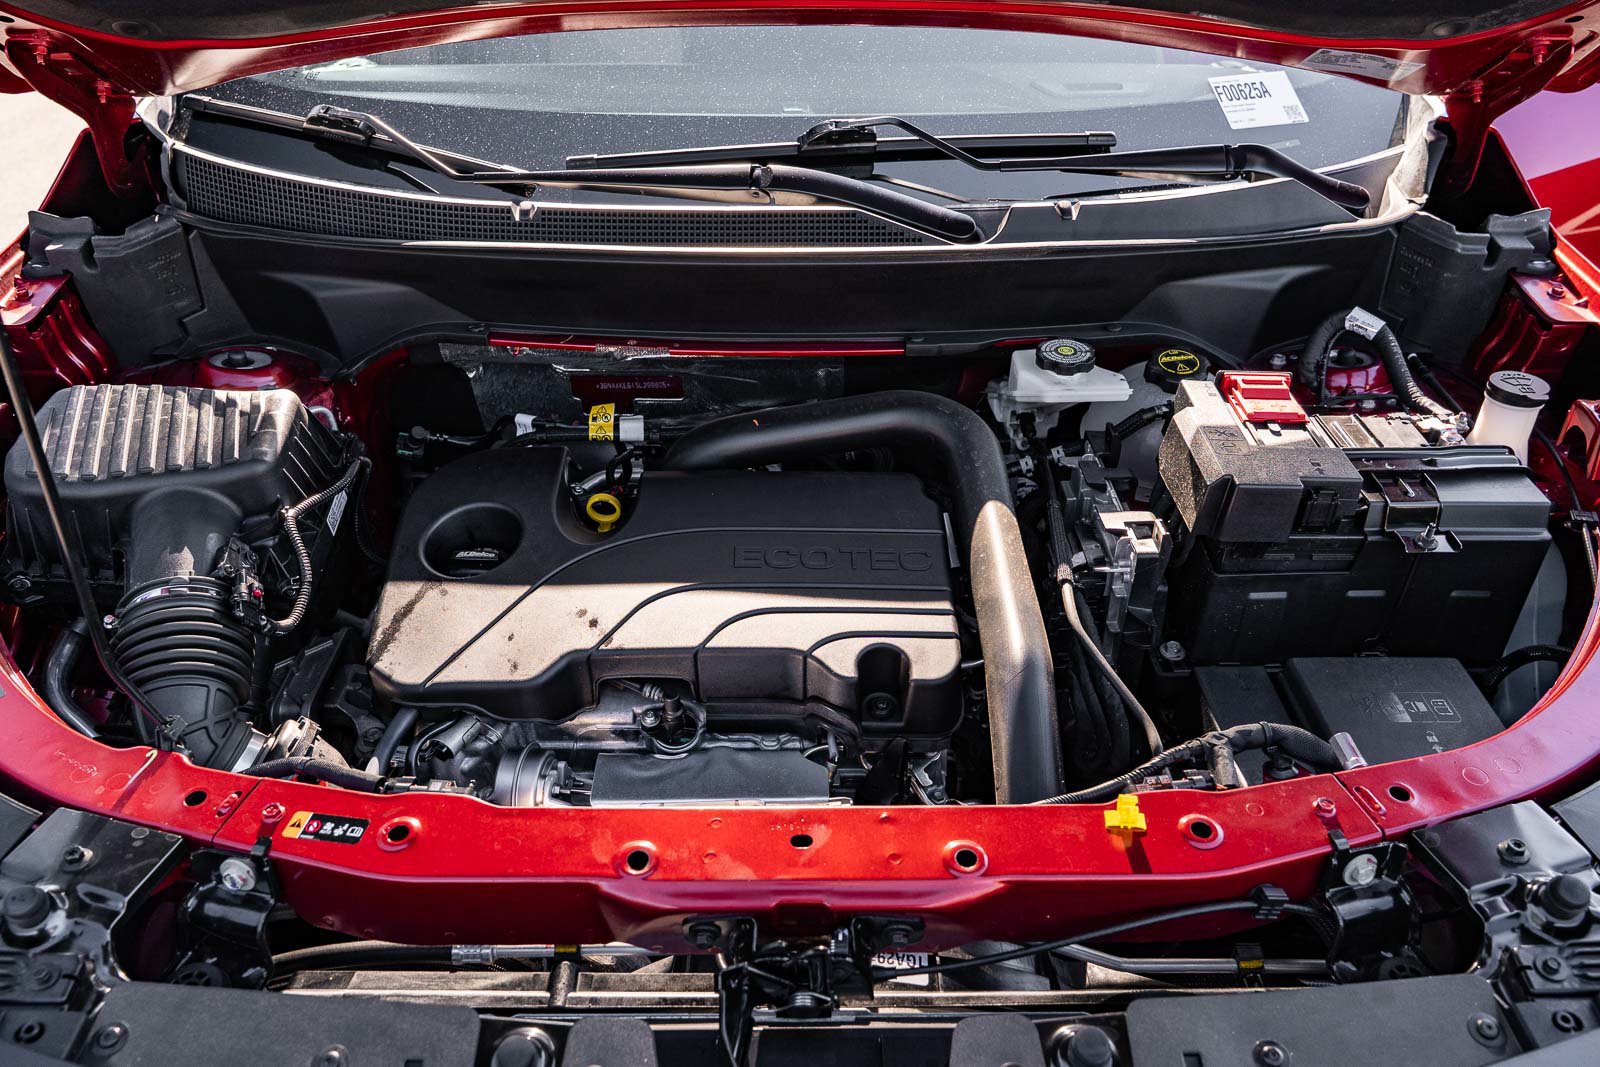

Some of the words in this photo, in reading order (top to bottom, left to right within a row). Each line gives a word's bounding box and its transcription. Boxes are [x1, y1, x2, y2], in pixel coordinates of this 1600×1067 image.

[1214, 81, 1272, 102] F00625A
[455, 550, 496, 558] ACDelco
[733, 545, 933, 572] ECOTEC
